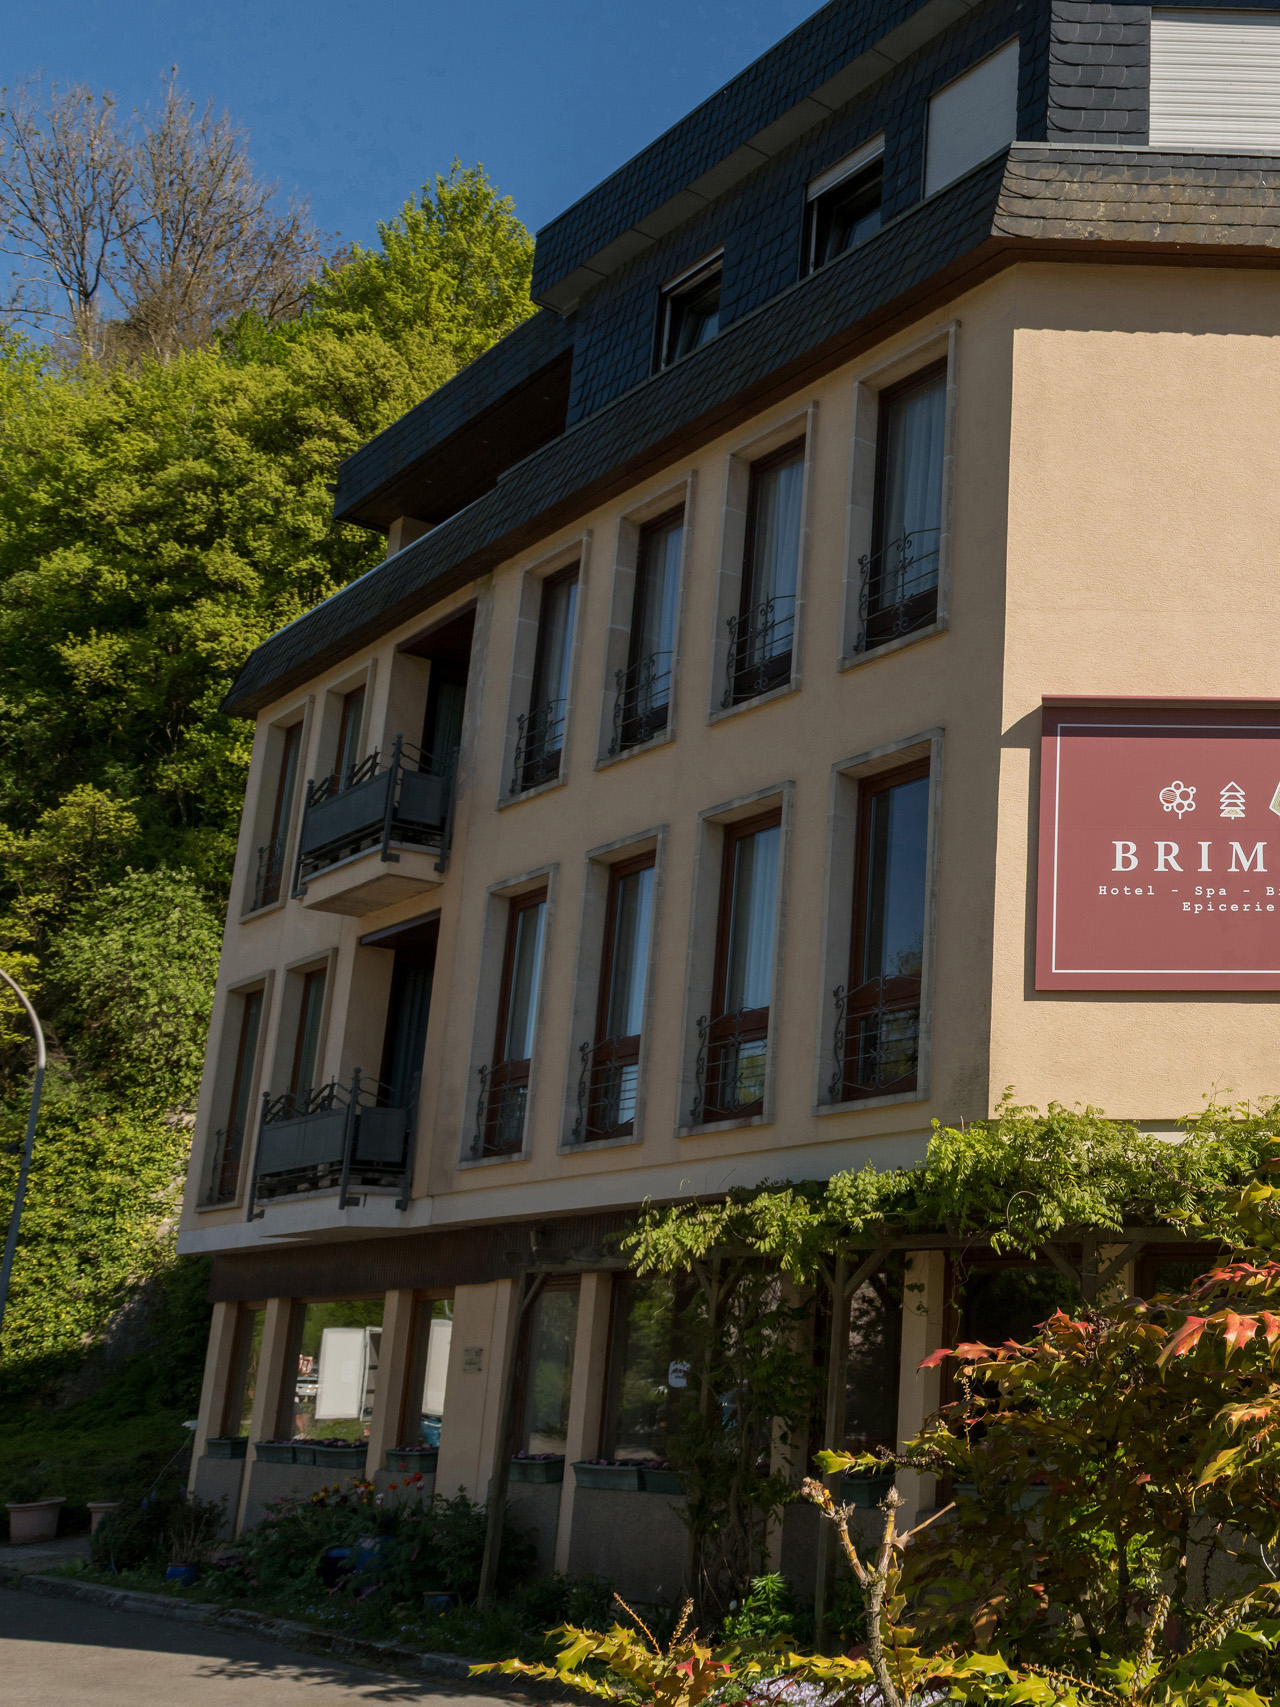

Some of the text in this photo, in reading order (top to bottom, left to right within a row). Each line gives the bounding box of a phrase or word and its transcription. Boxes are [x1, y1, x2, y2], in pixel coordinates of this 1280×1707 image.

[1098, 885, 1156, 896] Hotel
[1194, 886, 1228, 899] Spa
[1182, 901, 1276, 914] Epicerie
